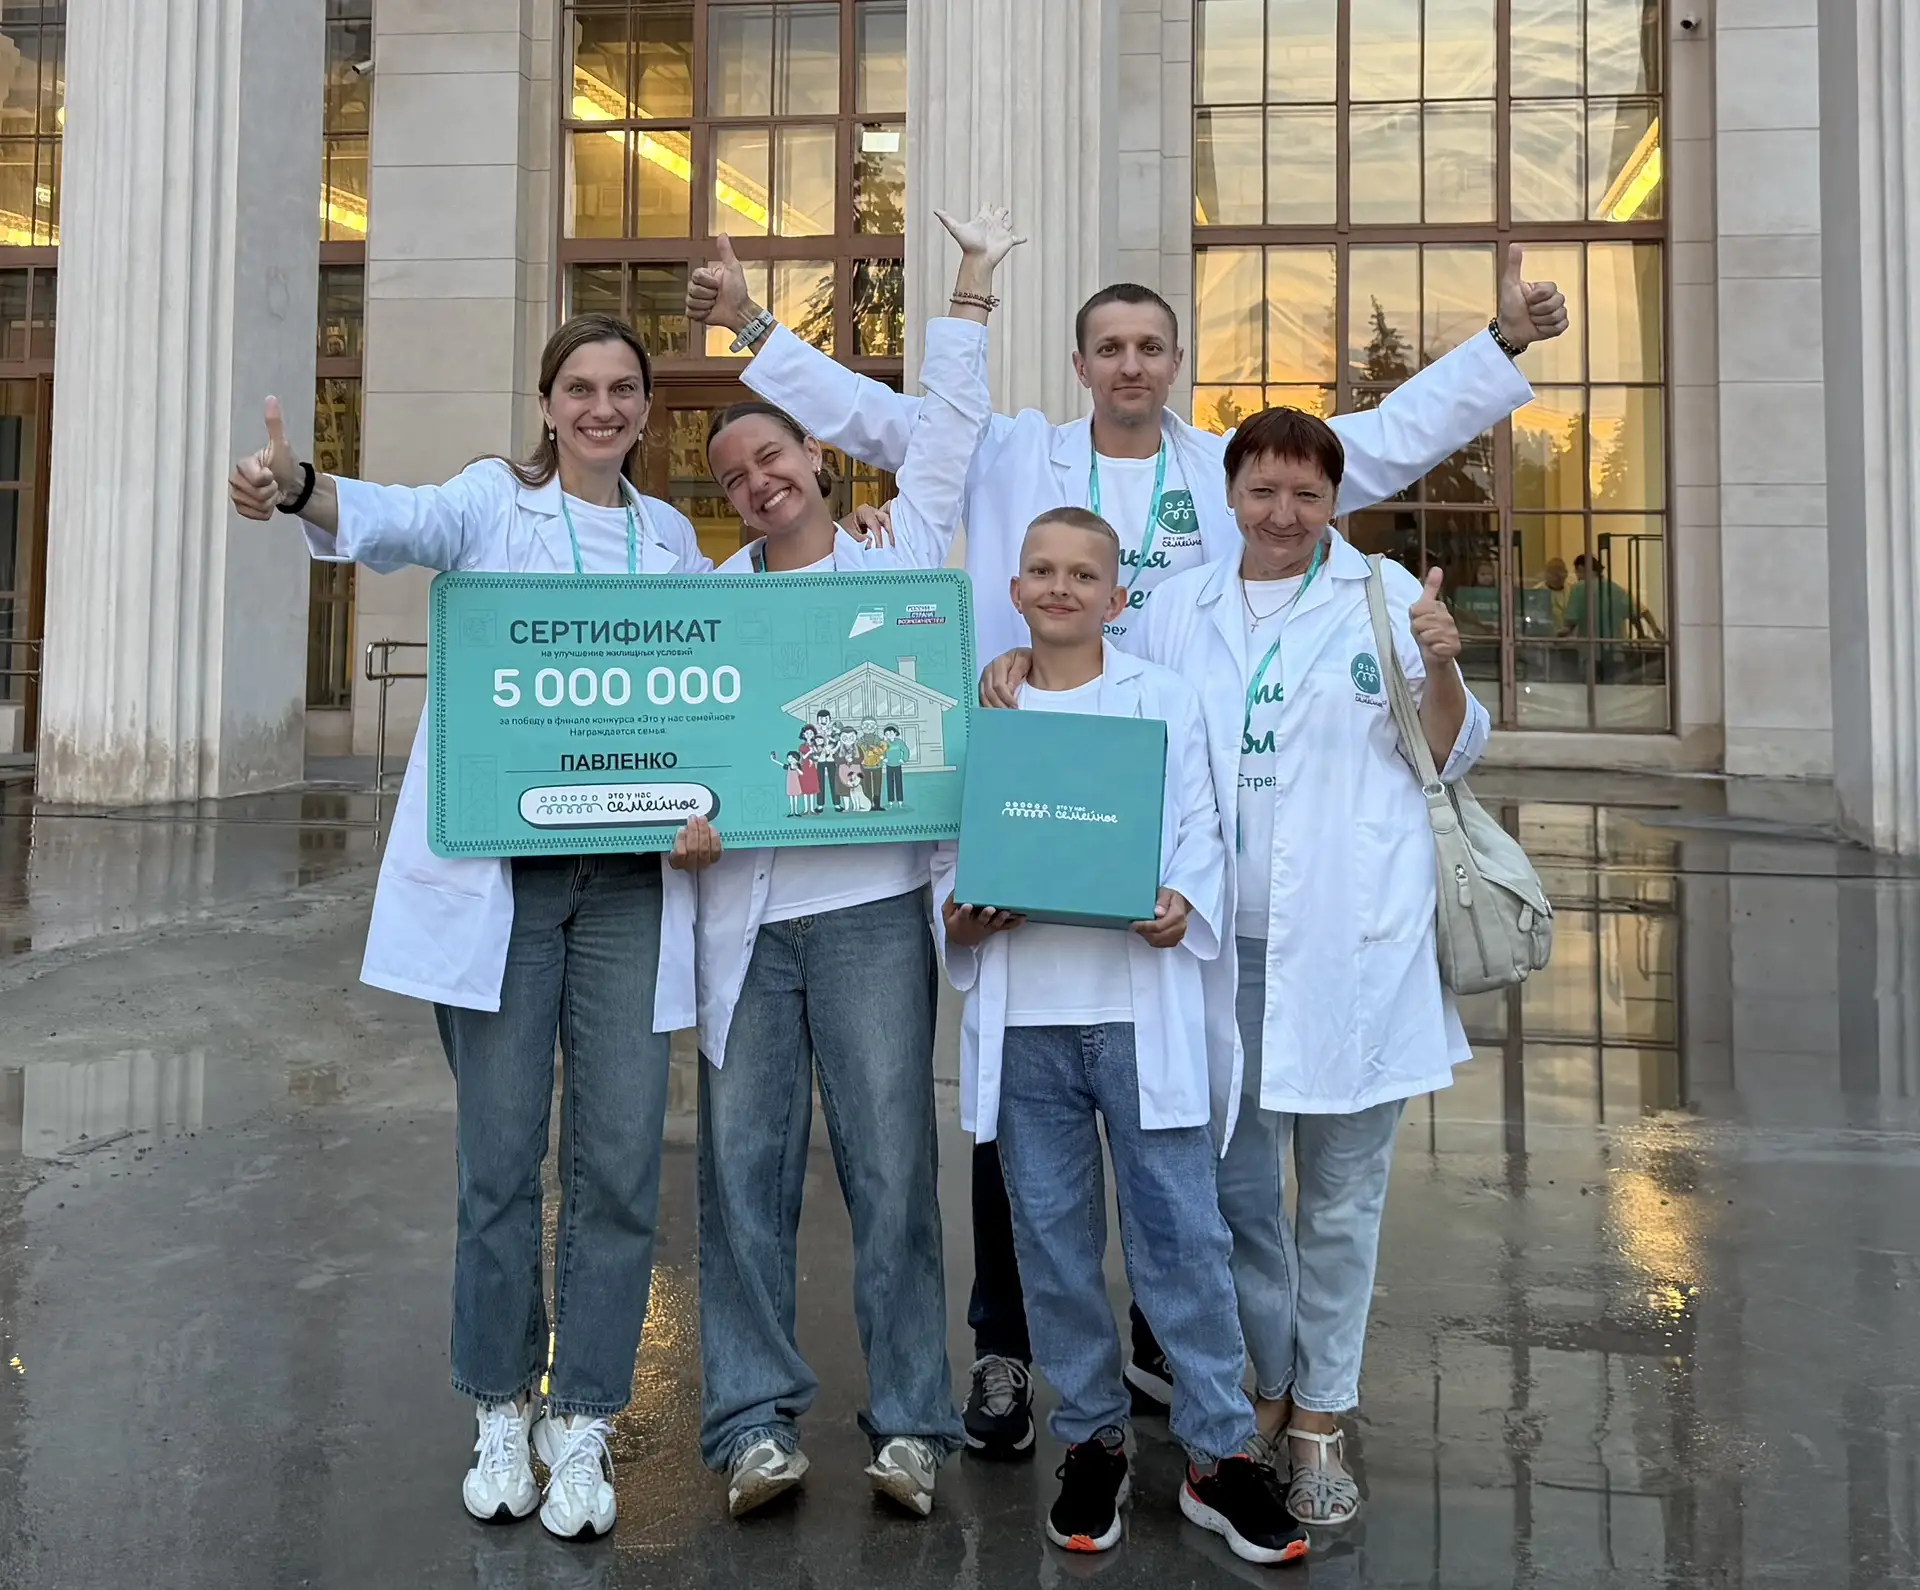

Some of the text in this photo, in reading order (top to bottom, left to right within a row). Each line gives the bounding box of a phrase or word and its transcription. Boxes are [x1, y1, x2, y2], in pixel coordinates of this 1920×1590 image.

[510, 619, 721, 645] СЕРТИФИКАТ
[553, 650, 604, 659] улучшение
[605, 649, 655, 658] жилищных
[656, 647, 693, 658] условий
[492, 665, 741, 708] 5 000 000
[511, 716, 544, 728] победу
[554, 716, 591, 727] финале
[592, 716, 635, 726] конкурса
[637, 713, 659, 724] «Это
[660, 716, 667, 725] у
[667, 714, 684, 722] нас
[685, 711, 736, 722] семейное»
[569, 728, 636, 738] Награждается
[560, 752, 678, 772] ПАВЛЕНКО
[607, 796, 700, 813] семейное
[608, 791, 652, 801] это у нас
[1055, 811, 1118, 822] семейное
